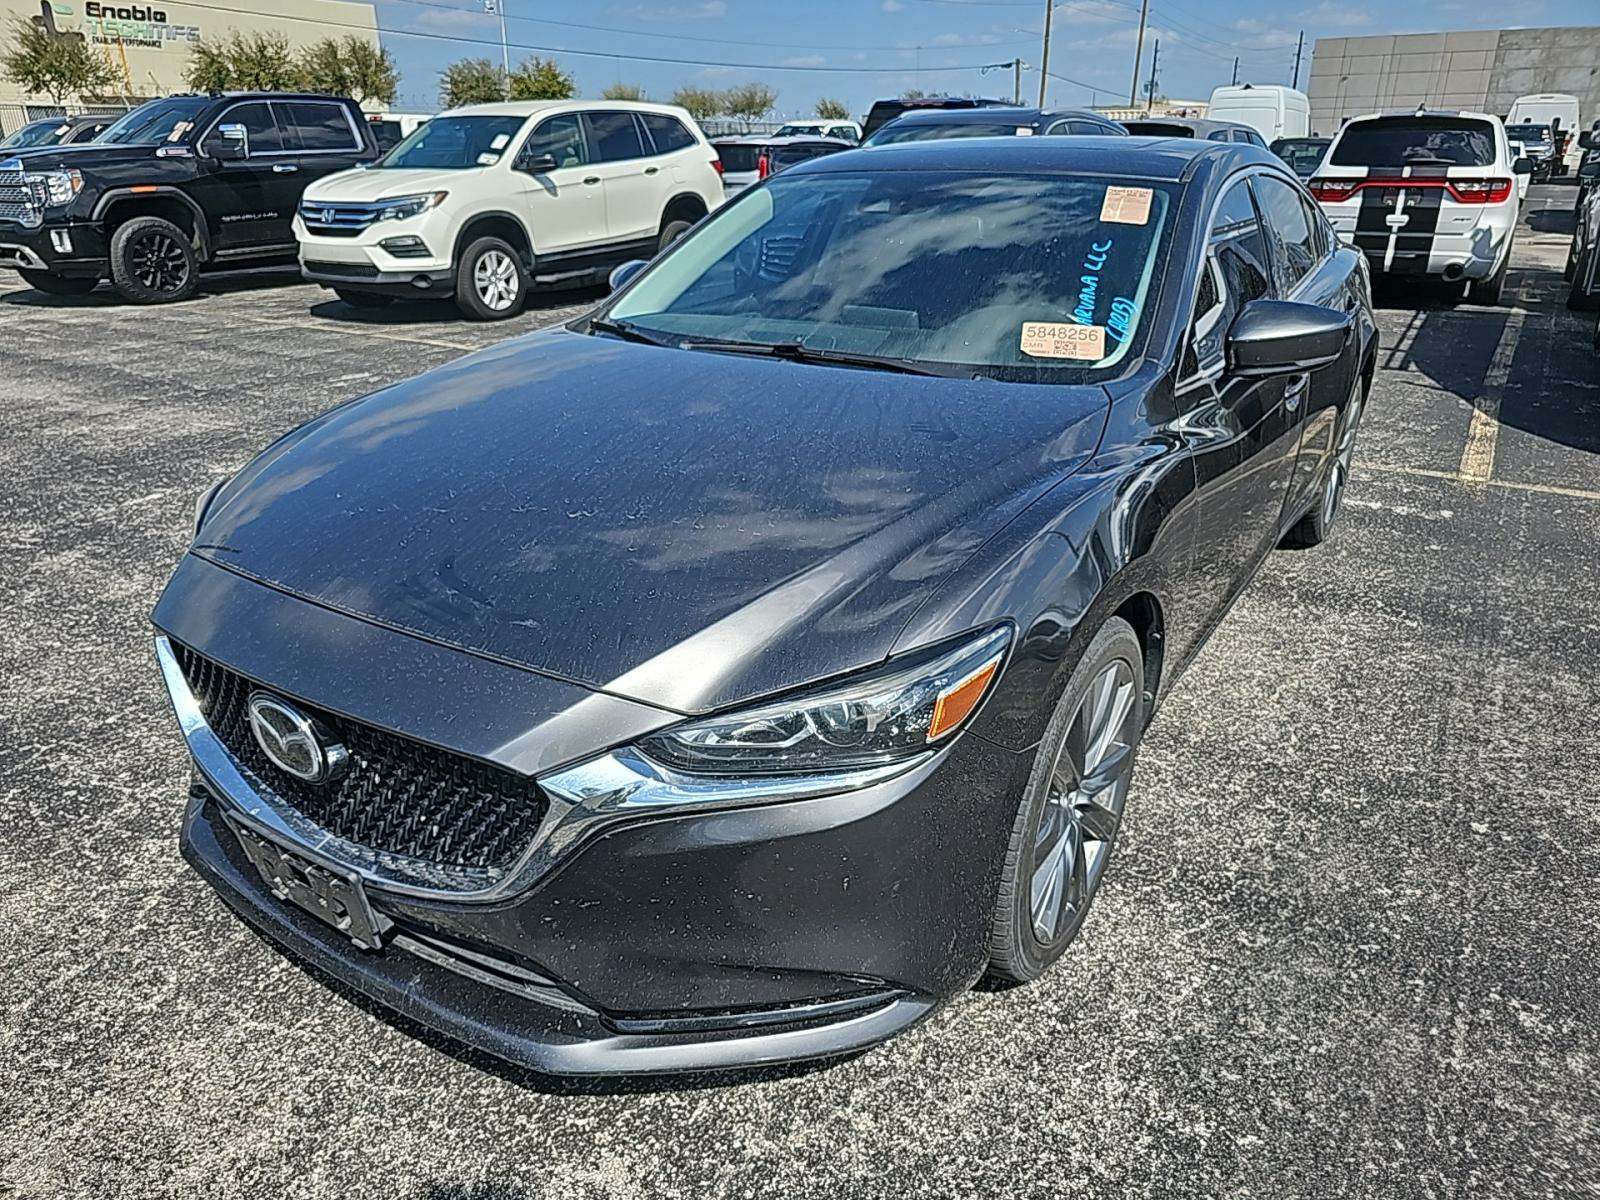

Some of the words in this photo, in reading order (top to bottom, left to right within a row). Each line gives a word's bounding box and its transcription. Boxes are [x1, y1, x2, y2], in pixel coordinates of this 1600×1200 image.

[1084, 239, 1112, 270] LLC
[1073, 274, 1099, 327] ARVANA
[1026, 326, 1099, 342] 5848256
